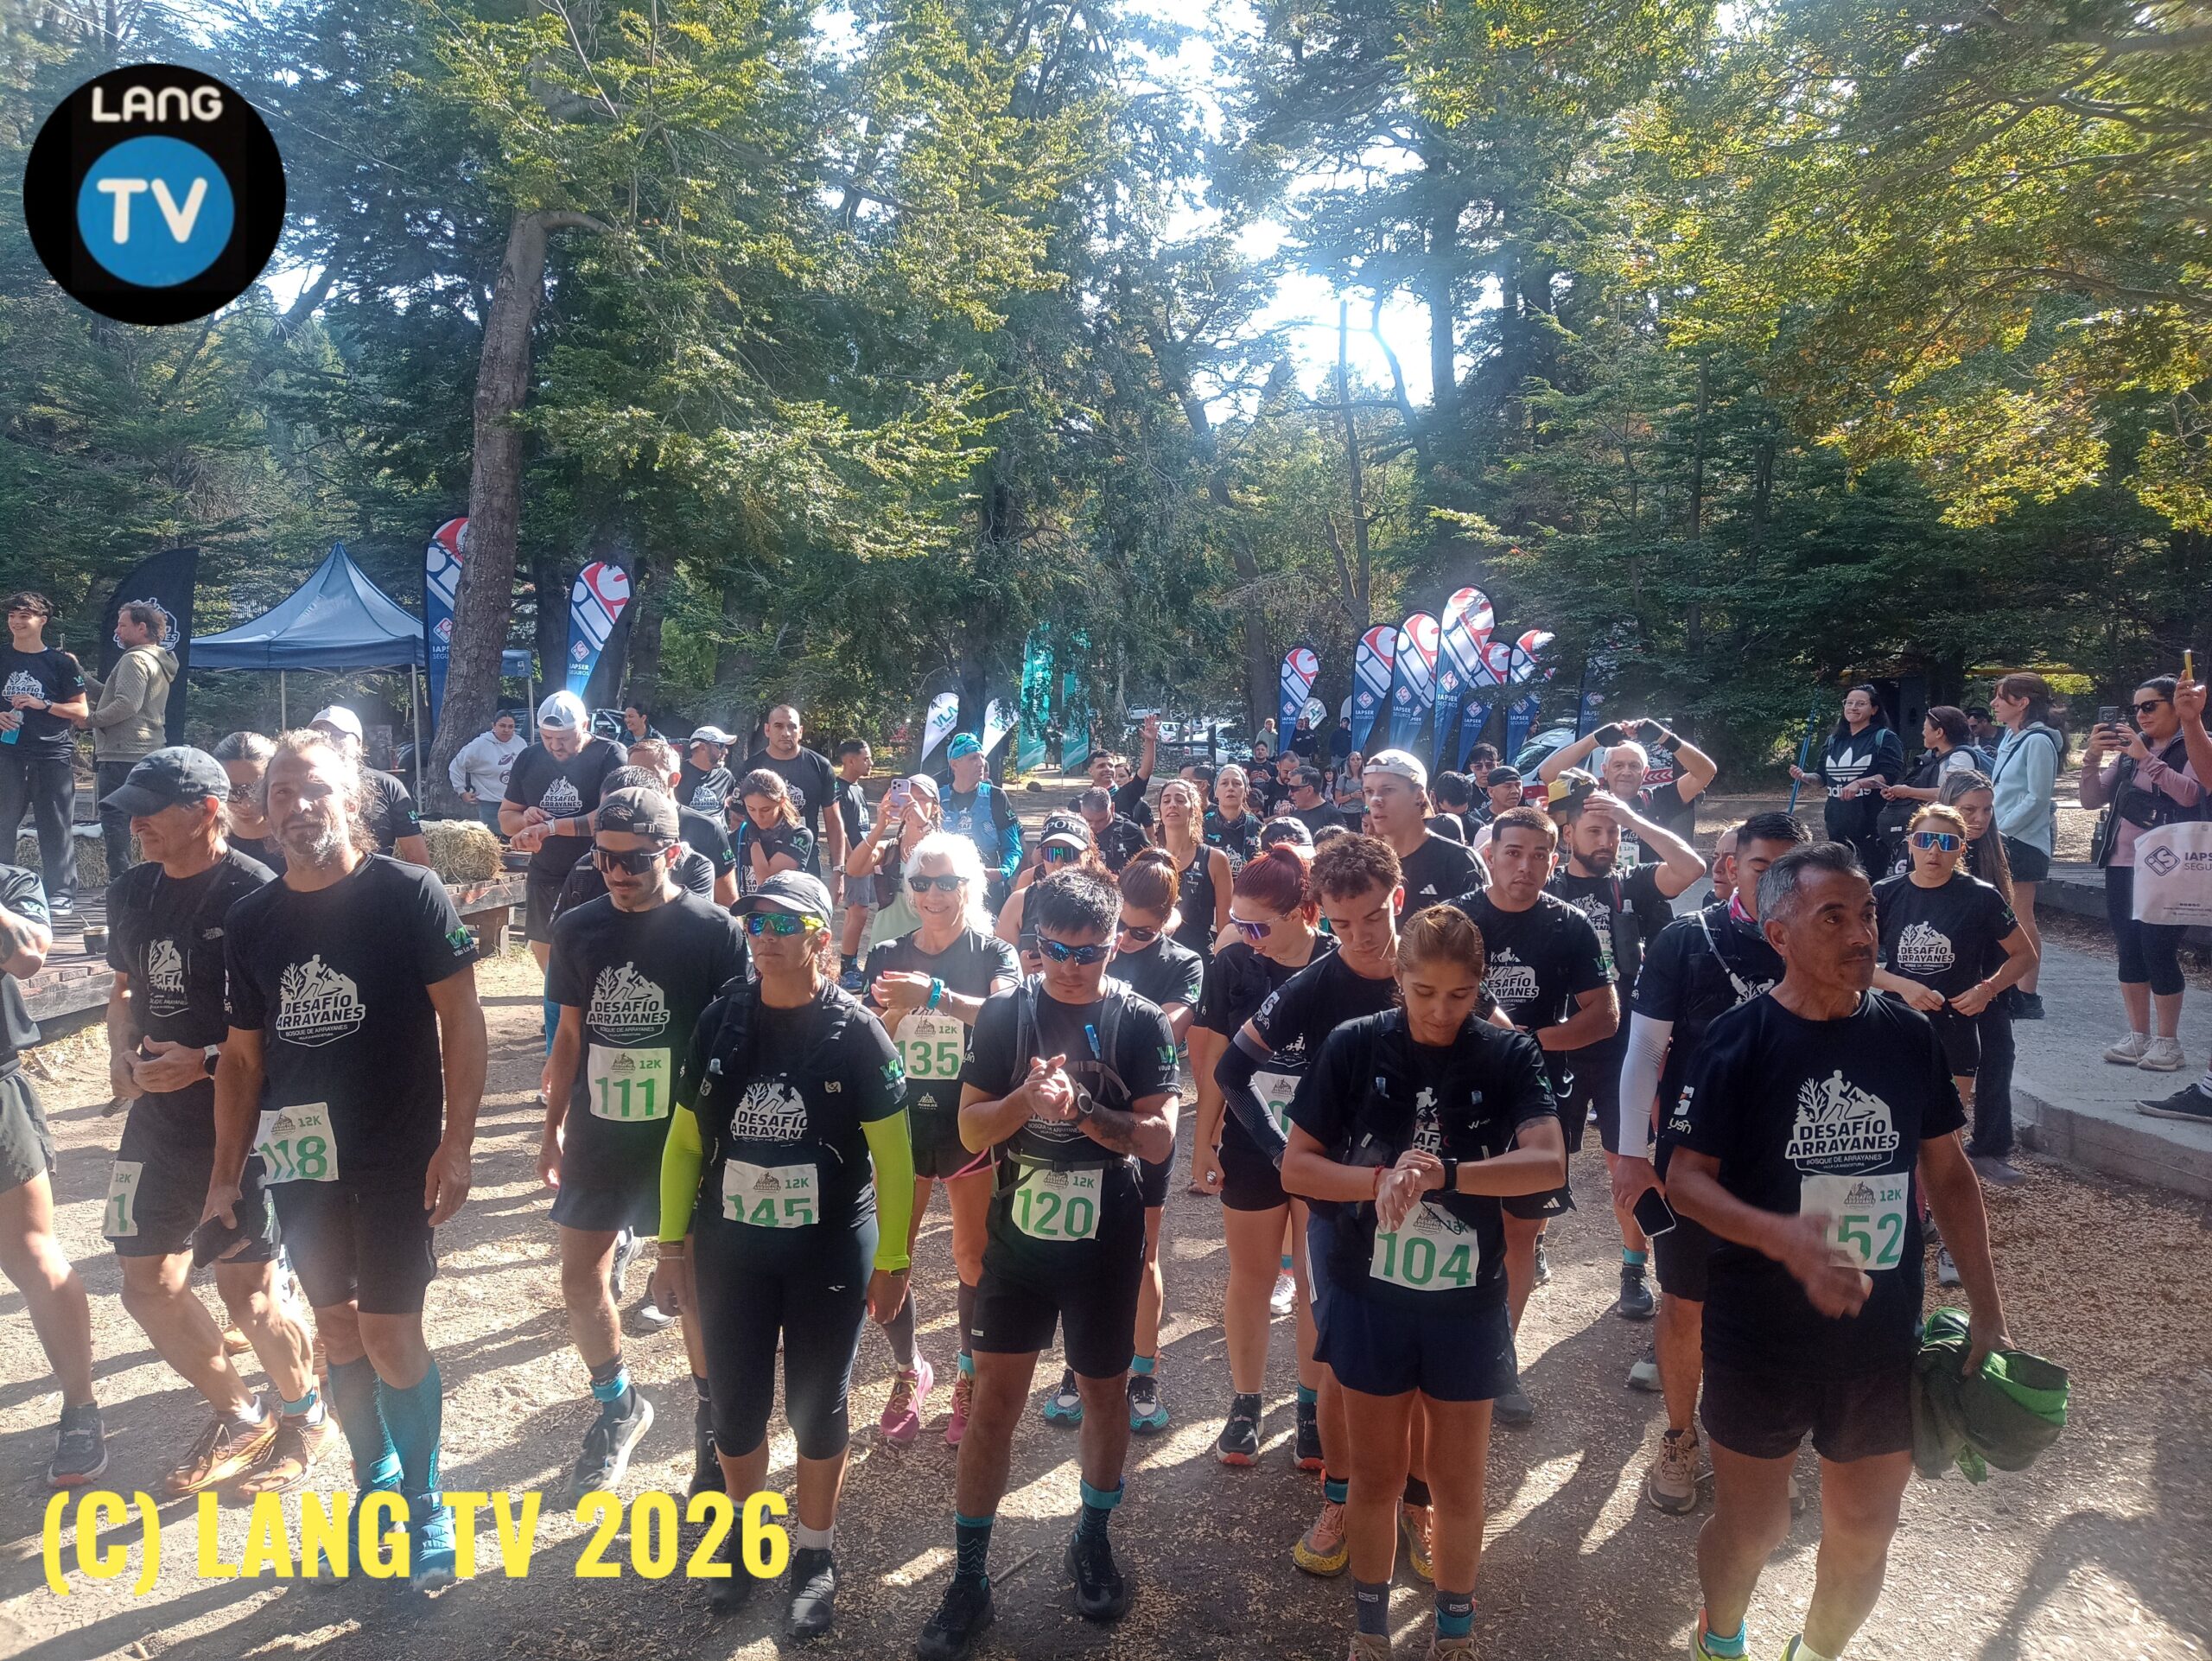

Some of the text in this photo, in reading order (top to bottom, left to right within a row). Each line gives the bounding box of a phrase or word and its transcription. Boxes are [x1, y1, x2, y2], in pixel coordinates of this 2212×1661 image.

[2184, 852, 2212, 862] IAP
[2183, 862, 2212, 871] SEGU
[1487, 976, 1531, 988] ESAFÍO
[1492, 987, 1538, 996] AYANES
[284, 993, 352, 1015] DESAFÍO
[594, 999, 659, 1013] DESAFÍO
[276, 1007, 363, 1028] ARRAYANES
[588, 1011, 669, 1024] ARRAYANES
[938, 1025, 958, 1034] 12K
[639, 1060, 662, 1069] 12K
[894, 1040, 959, 1077] 135
[594, 1078, 655, 1117] 111
[298, 1117, 322, 1128] 12K
[1800, 1117, 1885, 1141] DESAFÍO
[732, 1123, 805, 1139] ARRAYAN
[1789, 1134, 1897, 1157] ARRAYANES
[259, 1136, 327, 1180] 118
[1844, 1154, 1882, 1162] ARRAYANES
[115, 1173, 132, 1183] 12K
[785, 1178, 810, 1189] 12K
[1072, 1176, 1095, 1188] 12K
[1880, 1189, 1902, 1202] 12K
[726, 1193, 813, 1227] 145
[1017, 1188, 1094, 1238] 120
[1824, 1212, 1904, 1265] 52
[1376, 1231, 1472, 1286] 104
